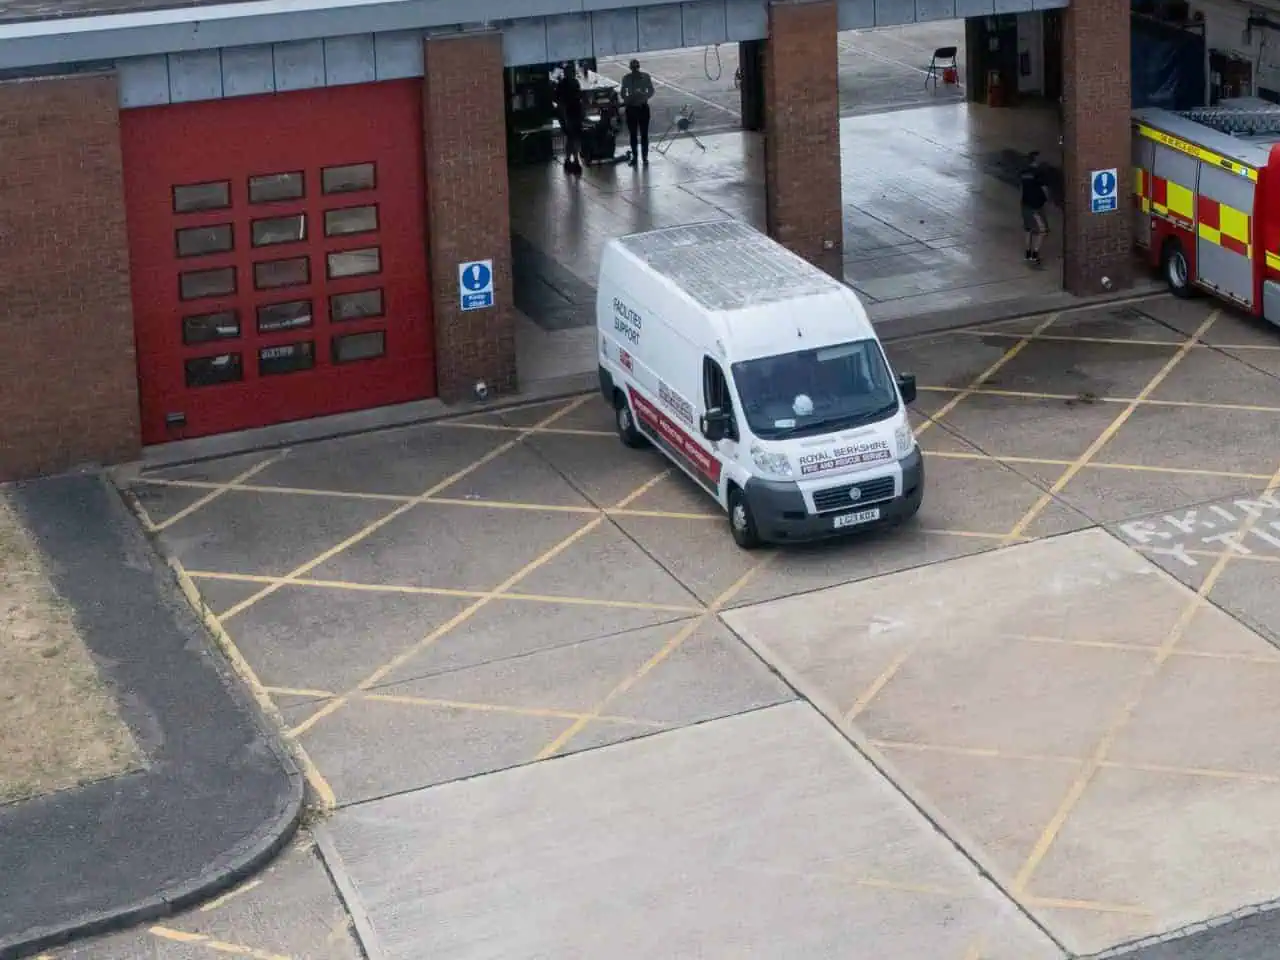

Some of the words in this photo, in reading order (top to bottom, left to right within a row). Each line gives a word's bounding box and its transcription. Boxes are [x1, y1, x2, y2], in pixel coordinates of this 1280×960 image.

[613, 297, 642, 329] FACILITIES
[614, 316, 640, 345] SUPPORT
[800, 451, 831, 465] ROYAL
[833, 440, 889, 457] BERKSHIRE
